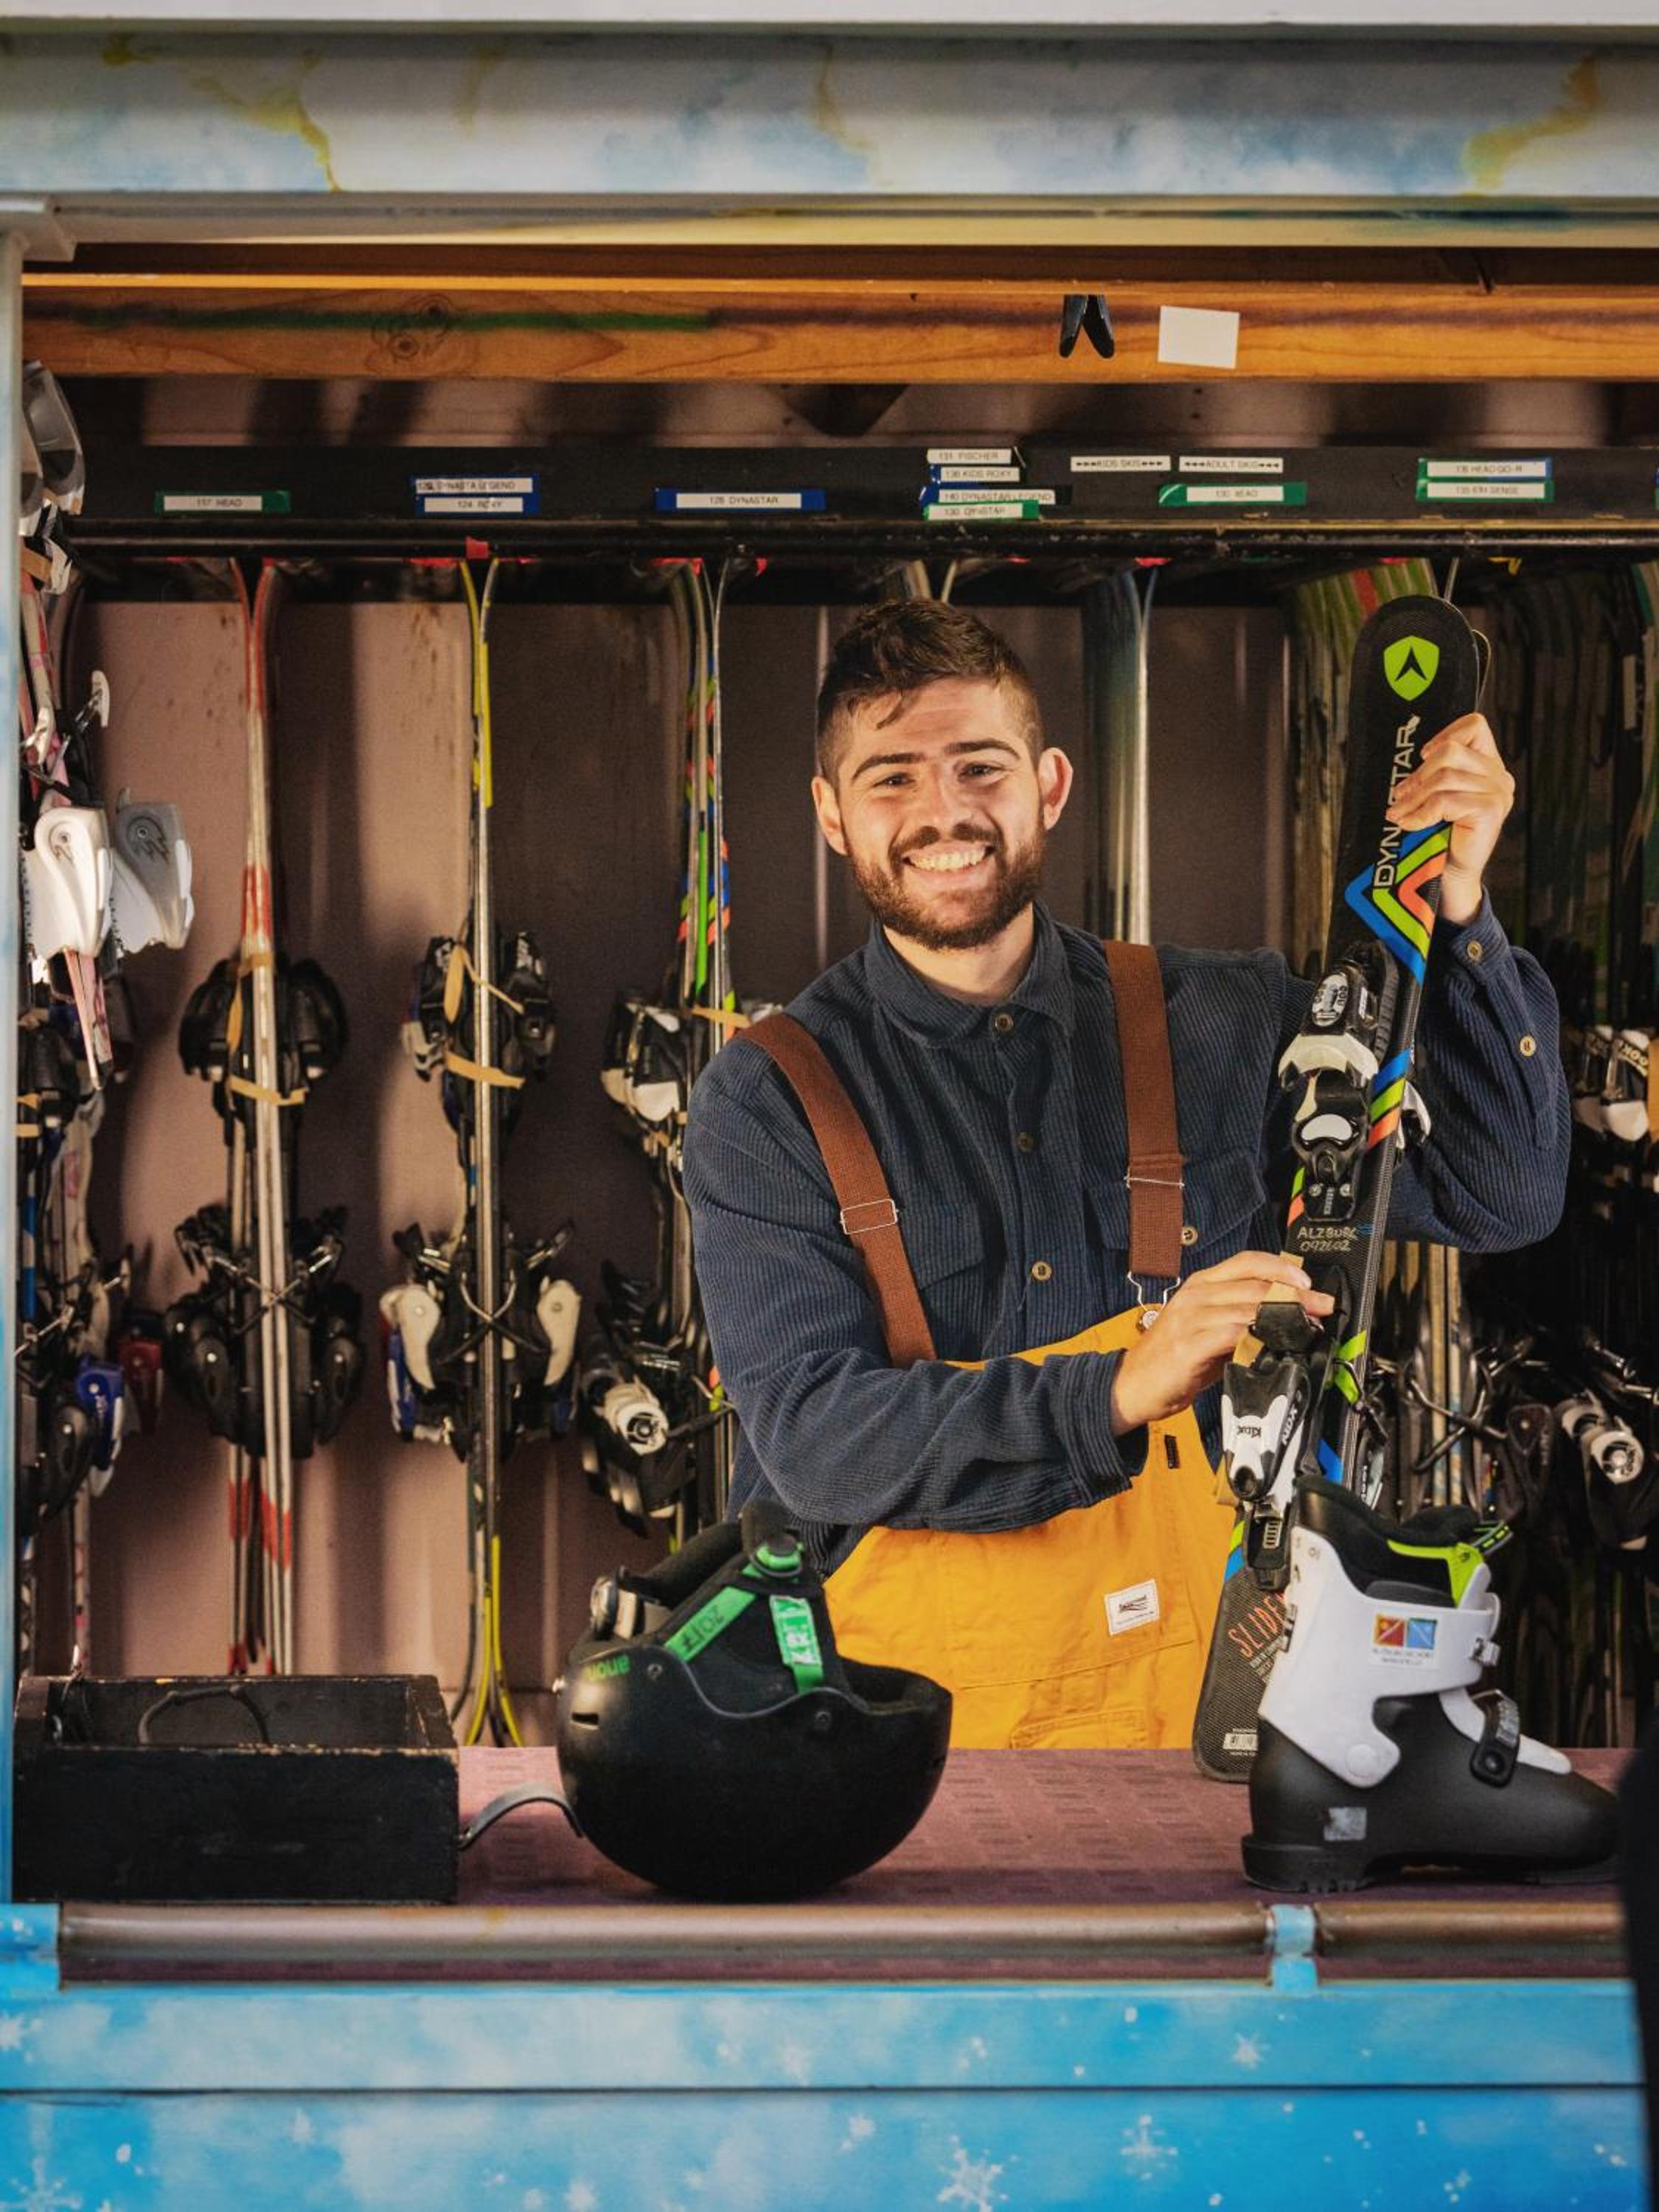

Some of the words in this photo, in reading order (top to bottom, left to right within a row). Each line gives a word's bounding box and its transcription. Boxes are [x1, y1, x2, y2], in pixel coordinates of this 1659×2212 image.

[959, 451, 999, 460] FISCHER
[1121, 459, 1142, 467] SKIS
[1206, 460, 1235, 468] ADULT
[962, 470, 984, 478] KIDS
[986, 470, 1012, 478] ROXY
[216, 498, 243, 507] HEAD
[728, 495, 779, 504] DYNASTAR
